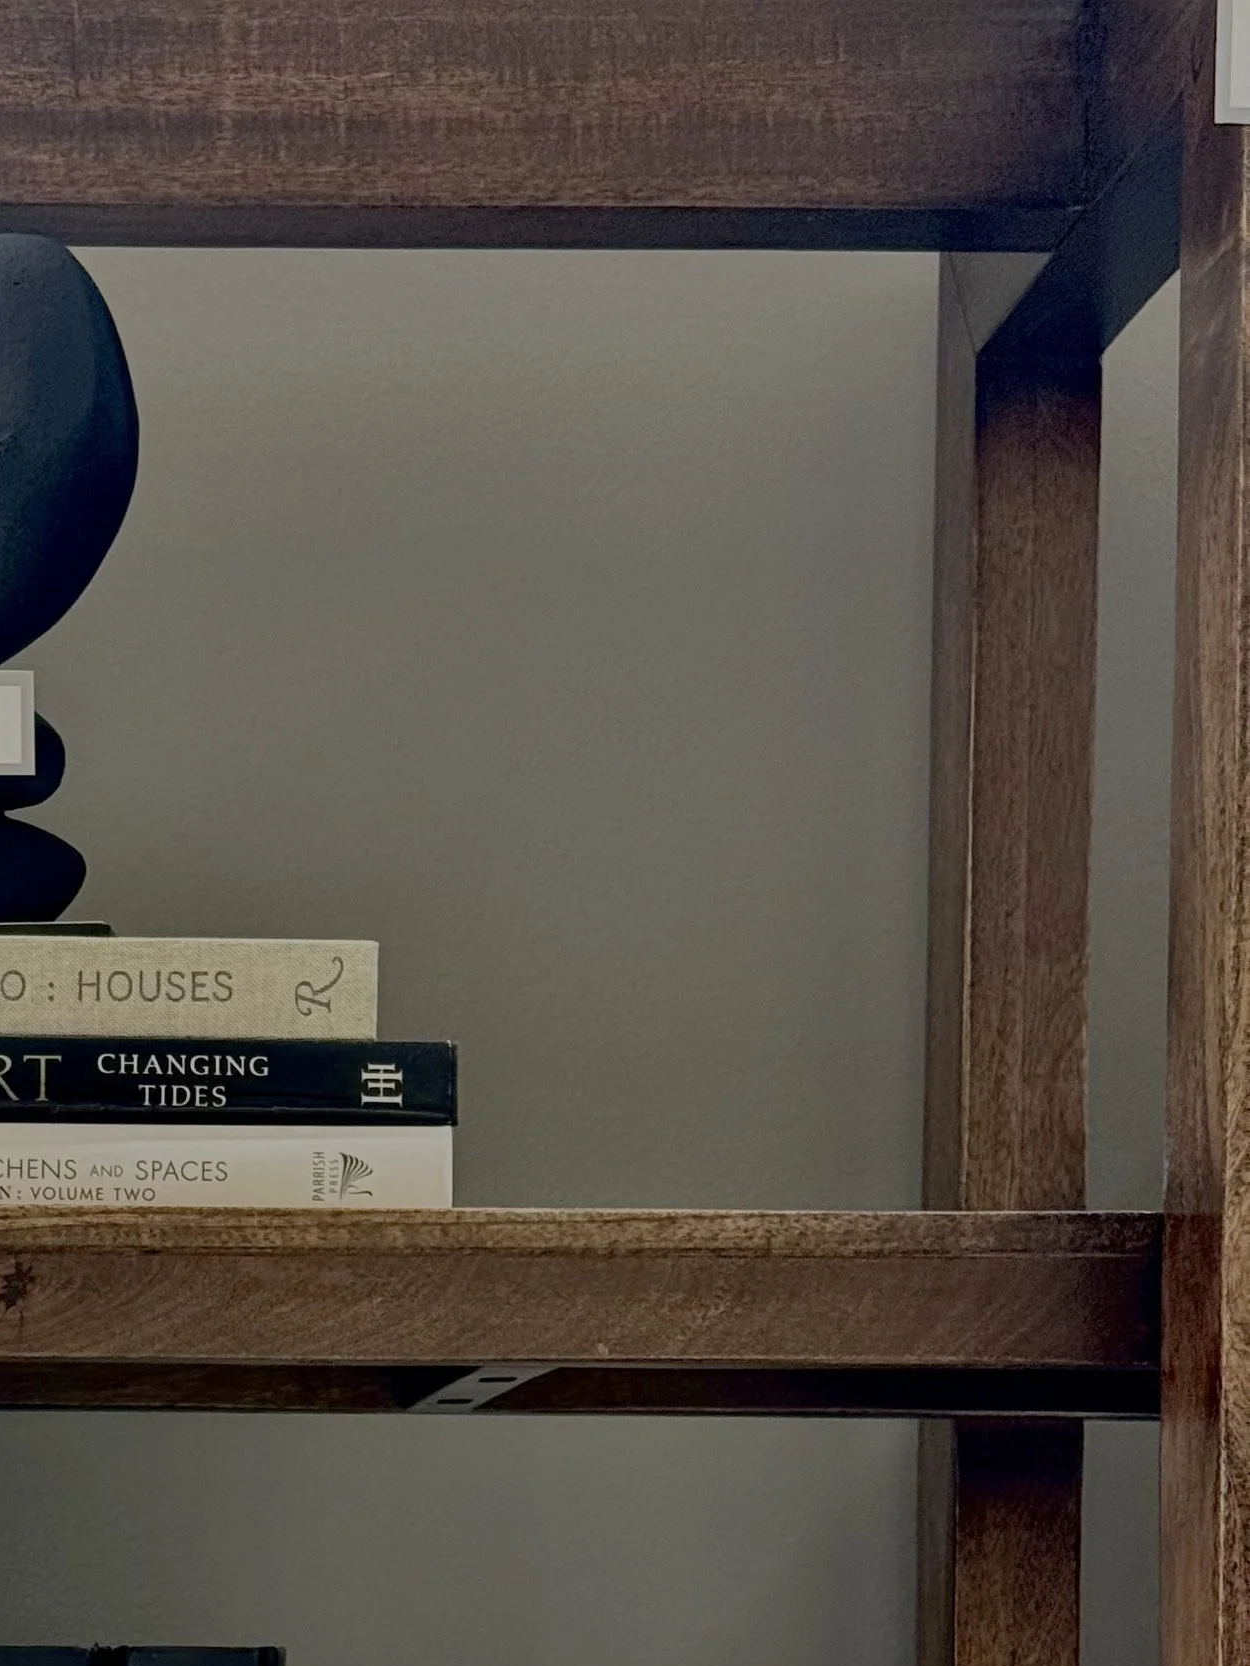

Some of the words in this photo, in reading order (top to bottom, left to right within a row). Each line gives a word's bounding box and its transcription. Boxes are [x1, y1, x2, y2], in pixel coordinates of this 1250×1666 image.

[76, 970, 235, 1003] HOUSES
[96, 1052, 271, 1078] CHANGING
[138, 1083, 228, 1108] TIDES
[89, 1163, 124, 1179] AND
[135, 1159, 229, 1182] SPACES
[311, 1151, 326, 1202] PARRISH
[329, 1159, 340, 1194] PRESS
[30, 1186, 104, 1202] VOLUME
[113, 1187, 156, 1202] TWO
